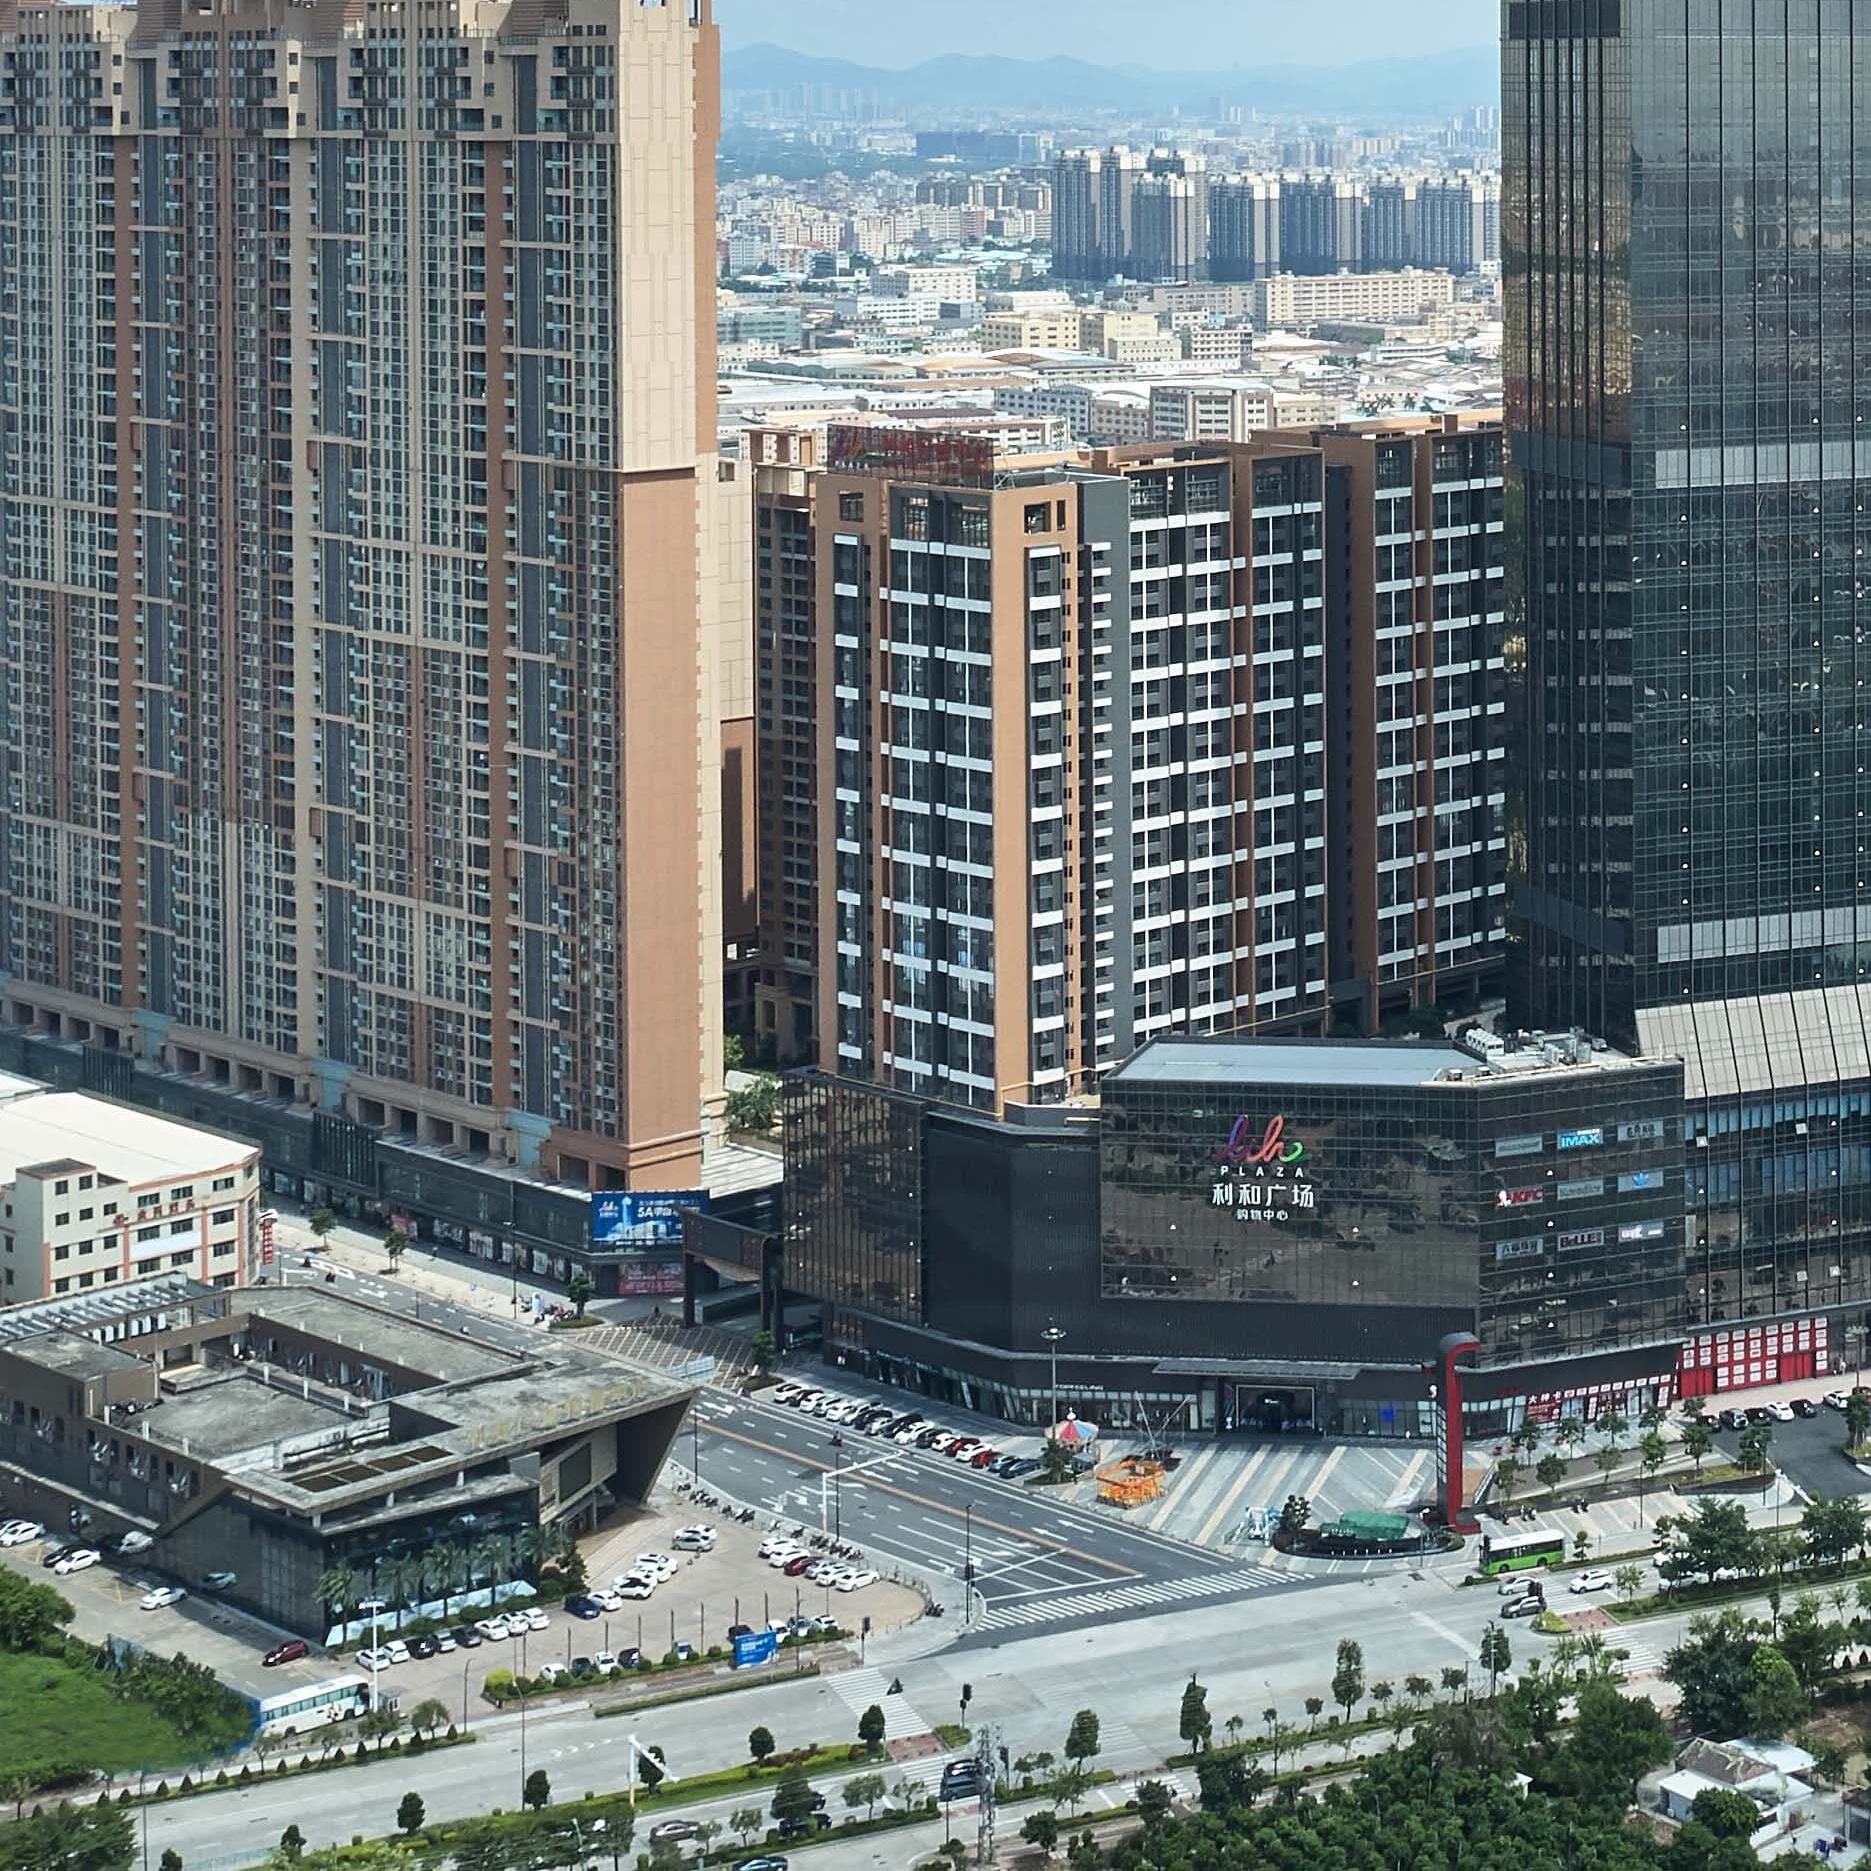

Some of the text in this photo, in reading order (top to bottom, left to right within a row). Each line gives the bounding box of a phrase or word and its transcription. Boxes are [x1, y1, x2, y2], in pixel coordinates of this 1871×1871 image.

[1560, 1133, 1600, 1148] IMAX
[1220, 1165, 1304, 1178] PLAZA
[1211, 1182, 1315, 1208] 利和广场
[1235, 1208, 1289, 1221] 购物中心
